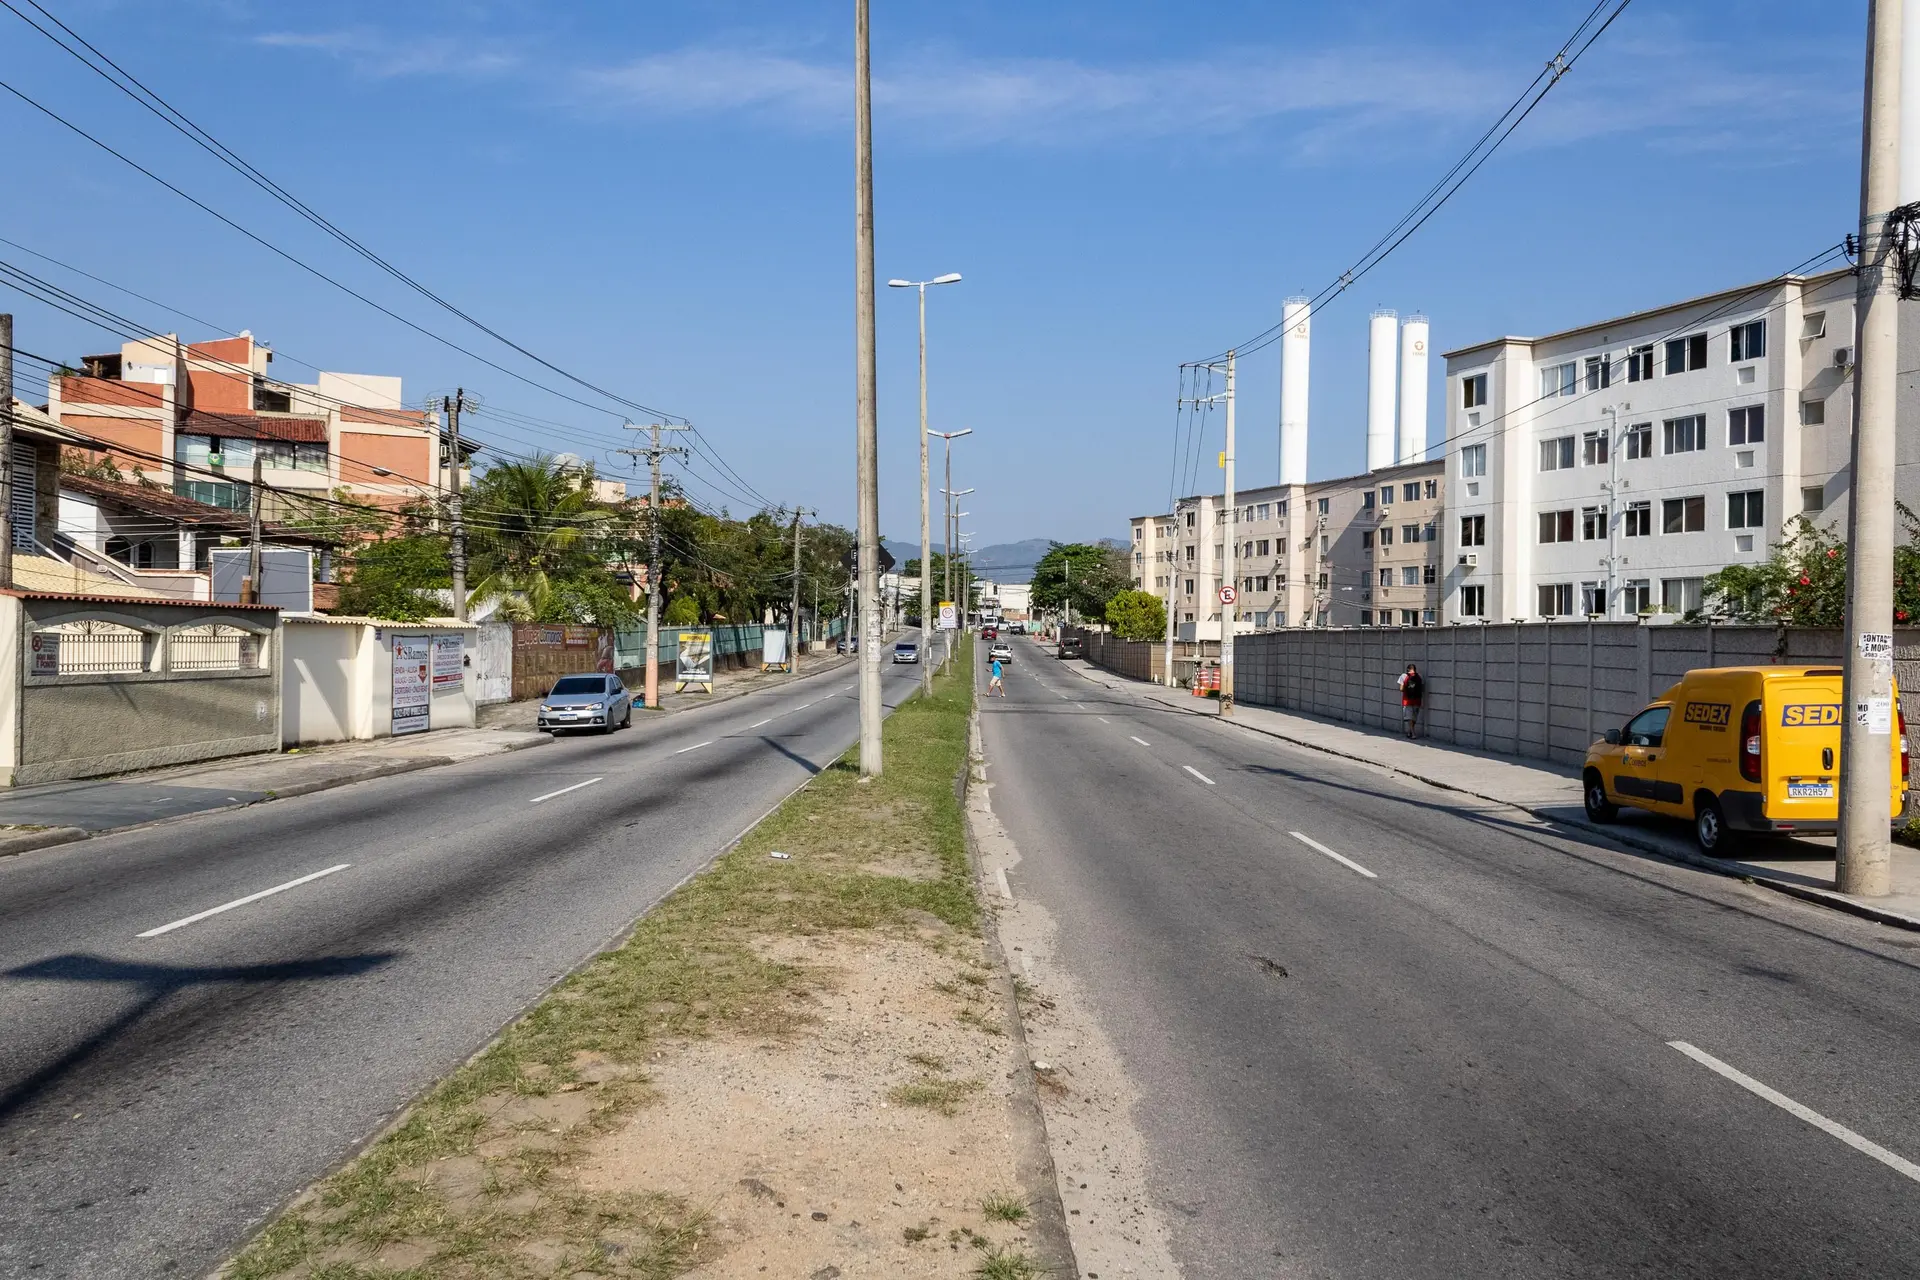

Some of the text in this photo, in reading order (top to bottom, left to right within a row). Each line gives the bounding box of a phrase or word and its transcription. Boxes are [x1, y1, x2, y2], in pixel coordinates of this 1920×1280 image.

[1225, 590, 1231, 600] E
[1857, 703, 1869, 712] MO
[1686, 703, 1730, 724] SEDEX
[1785, 705, 1842, 725] SED
[1792, 788, 1828, 797] RKR2H57
